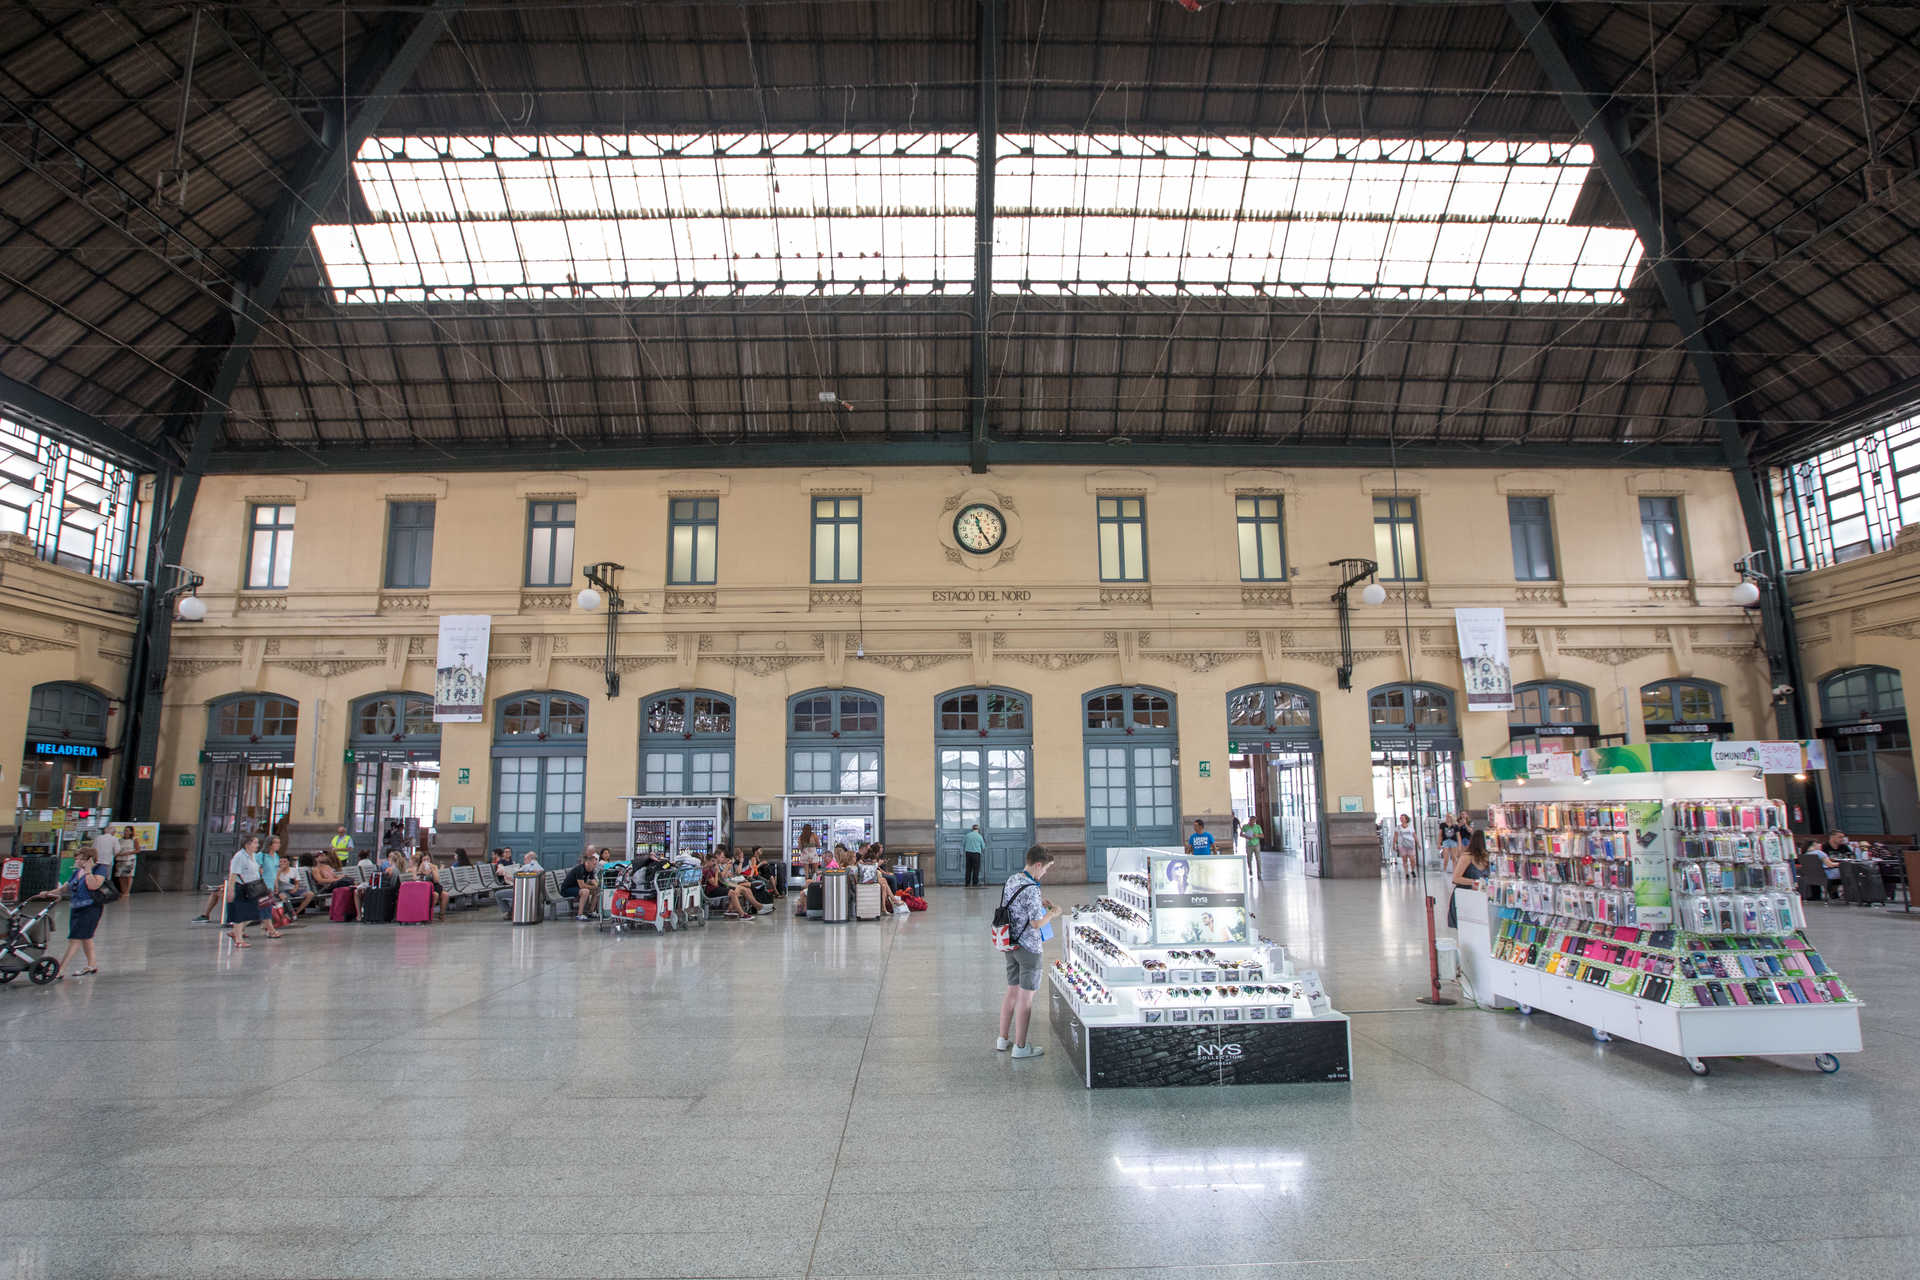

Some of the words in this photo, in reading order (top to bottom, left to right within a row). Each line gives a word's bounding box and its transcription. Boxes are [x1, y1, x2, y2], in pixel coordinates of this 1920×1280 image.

[932, 589, 976, 601] ESTACIÓ
[978, 591, 1000, 601] DEL
[1001, 590, 1032, 601] NORD
[36, 743, 98, 757] HELADERIA
[1197, 1043, 1242, 1056] NYS
